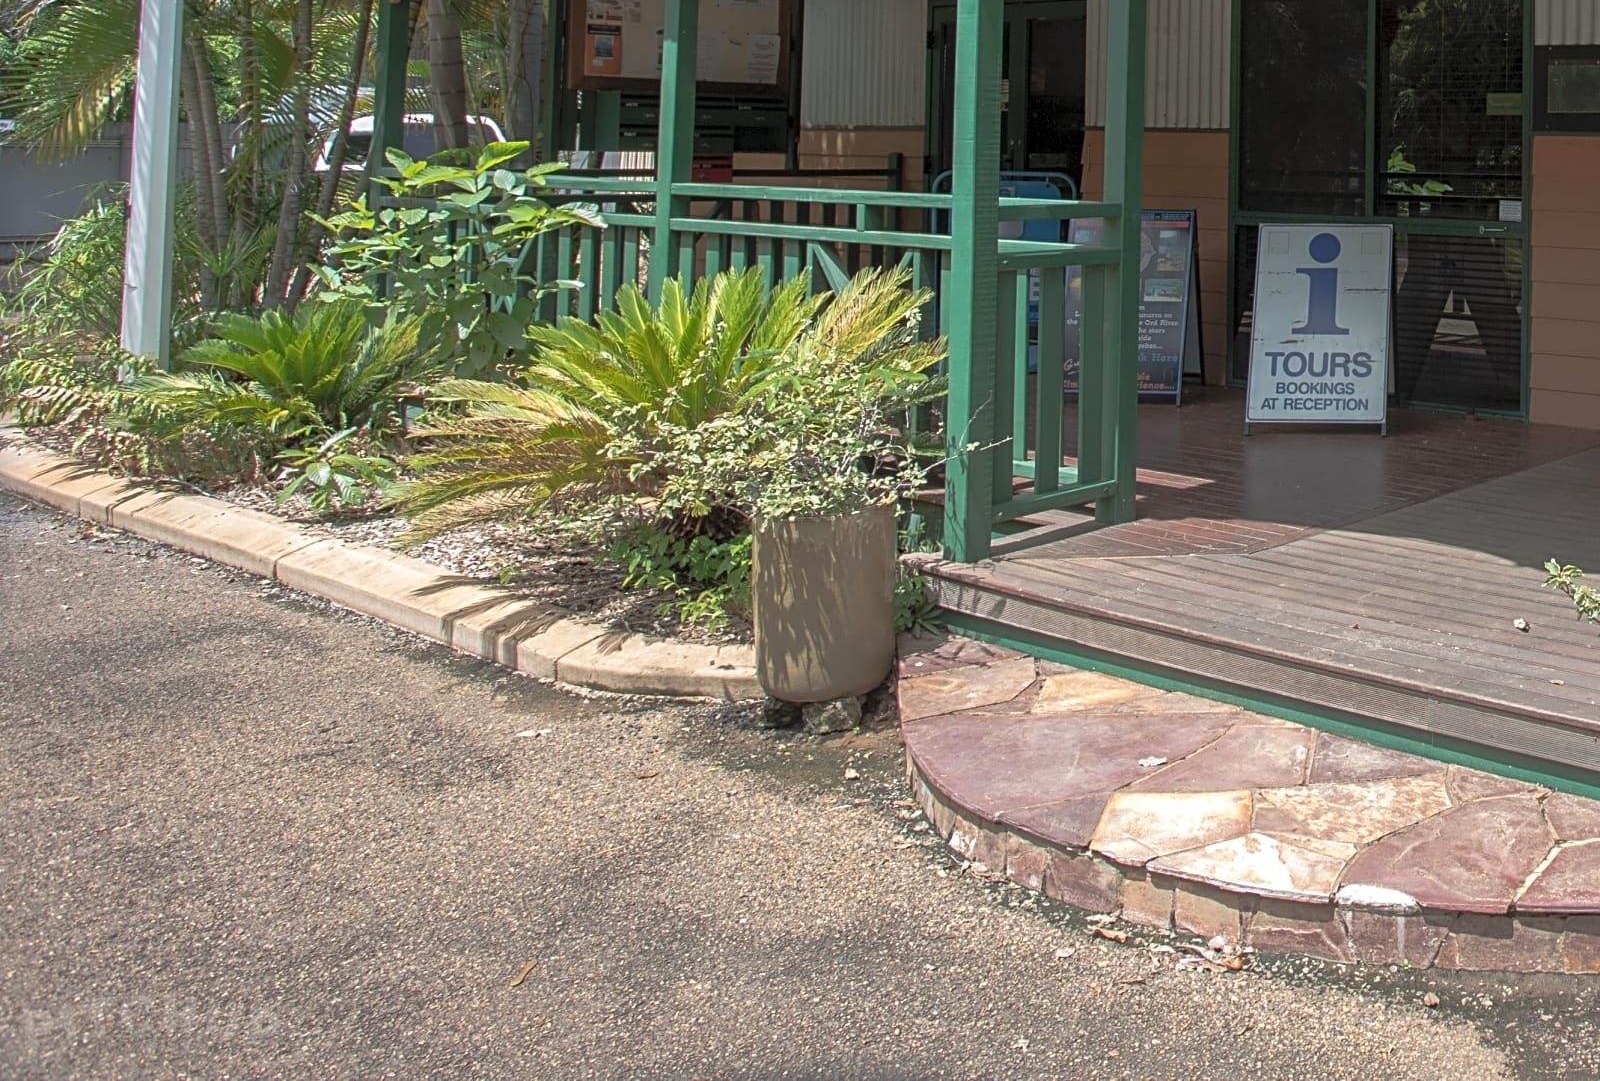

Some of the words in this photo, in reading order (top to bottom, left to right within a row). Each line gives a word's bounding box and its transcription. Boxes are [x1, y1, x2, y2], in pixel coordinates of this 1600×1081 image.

[1265, 351, 1373, 378] TOURS
[1275, 381, 1356, 395] BOOKINGS
[1260, 397, 1279, 410] AT
[1283, 398, 1369, 411] RECEPTION
